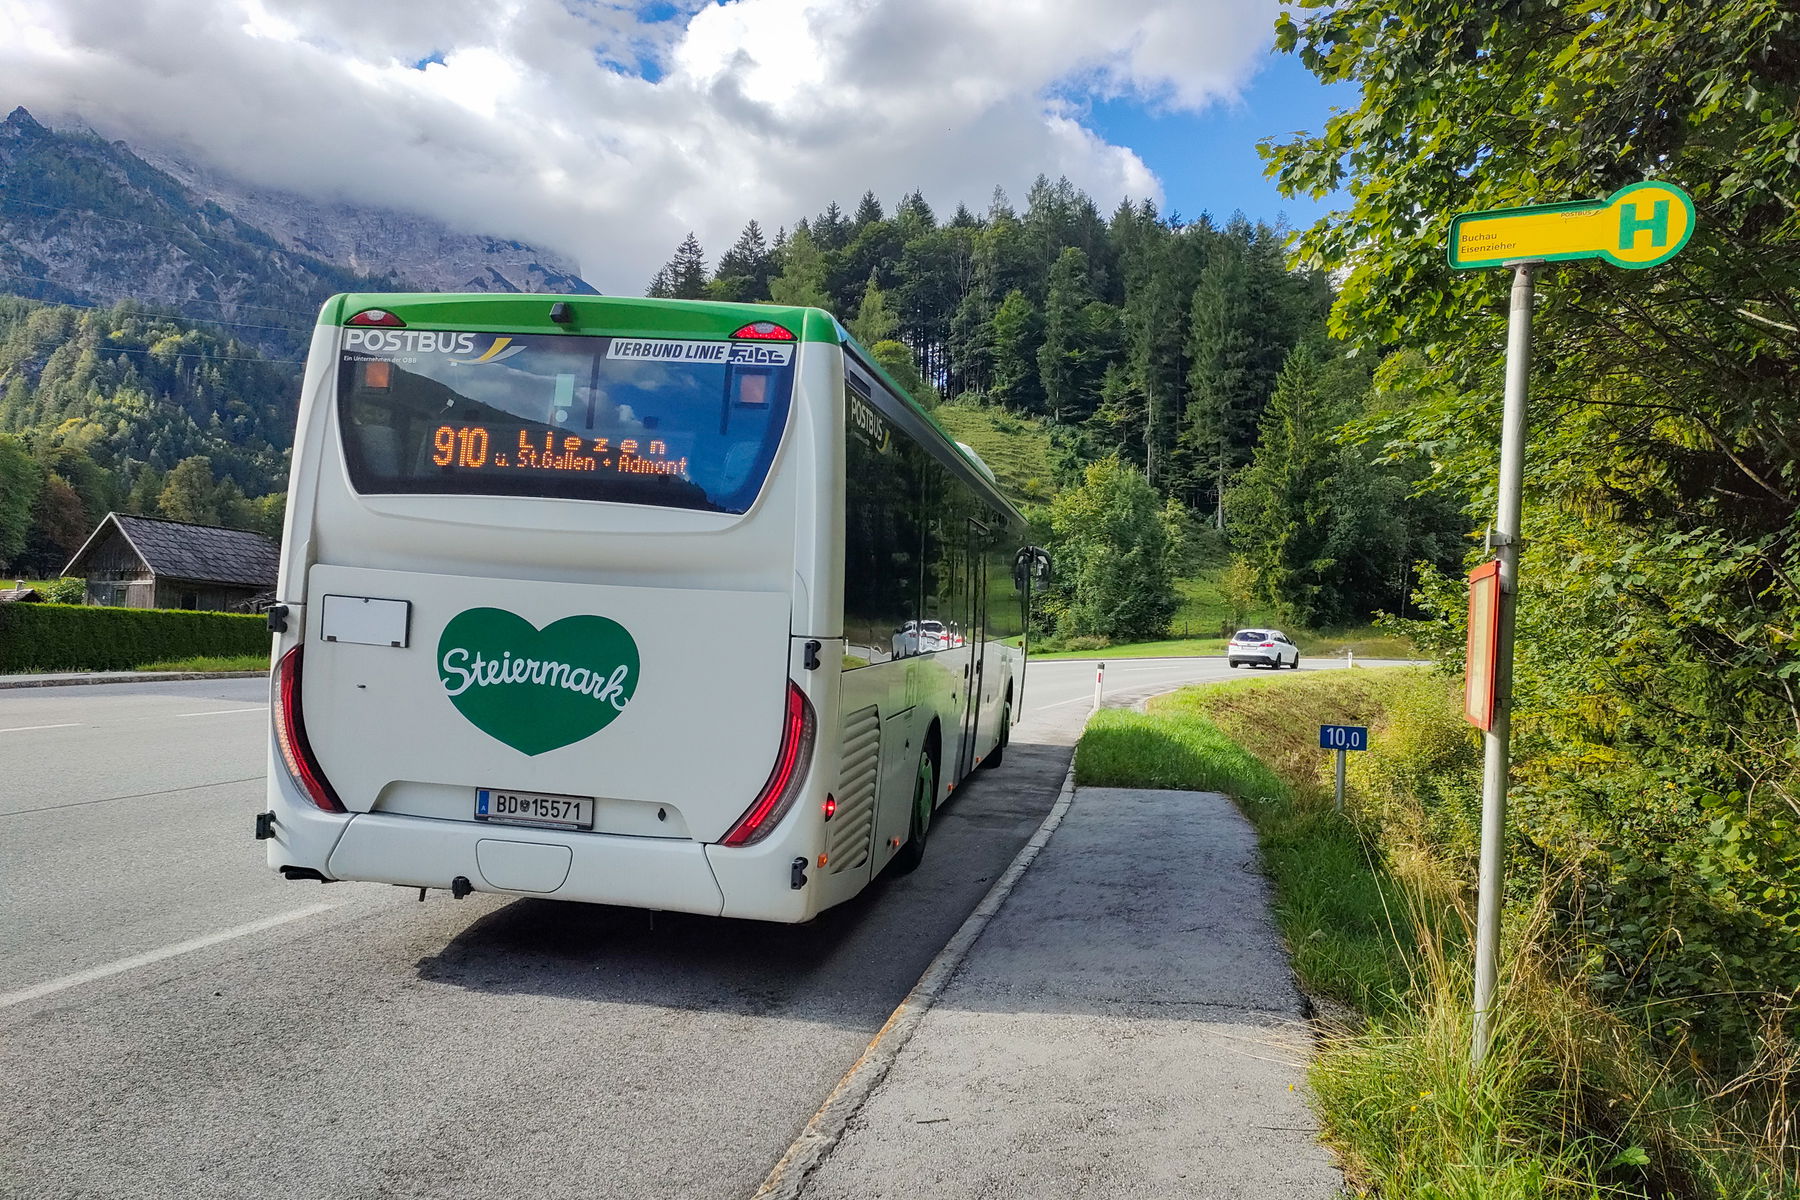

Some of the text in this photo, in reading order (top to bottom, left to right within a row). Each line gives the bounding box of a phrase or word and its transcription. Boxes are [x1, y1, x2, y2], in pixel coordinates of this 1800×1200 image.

[1618, 199, 1671, 250] H
[1461, 233, 1498, 243] Buchau
[1461, 240, 1517, 254] Eisenzieher
[346, 330, 476, 354] POSTBUS
[614, 341, 726, 360] VERBUND LINIE
[353, 355, 391, 363] Unternehmen
[851, 396, 883, 441] POSTBUS
[433, 426, 666, 468] 910 Liezen
[618, 454, 688, 476] Admont
[441, 648, 630, 711] Steiermark
[1326, 727, 1360, 749] 10,0
[496, 795, 519, 814] BD
[531, 798, 581, 820] 15571
